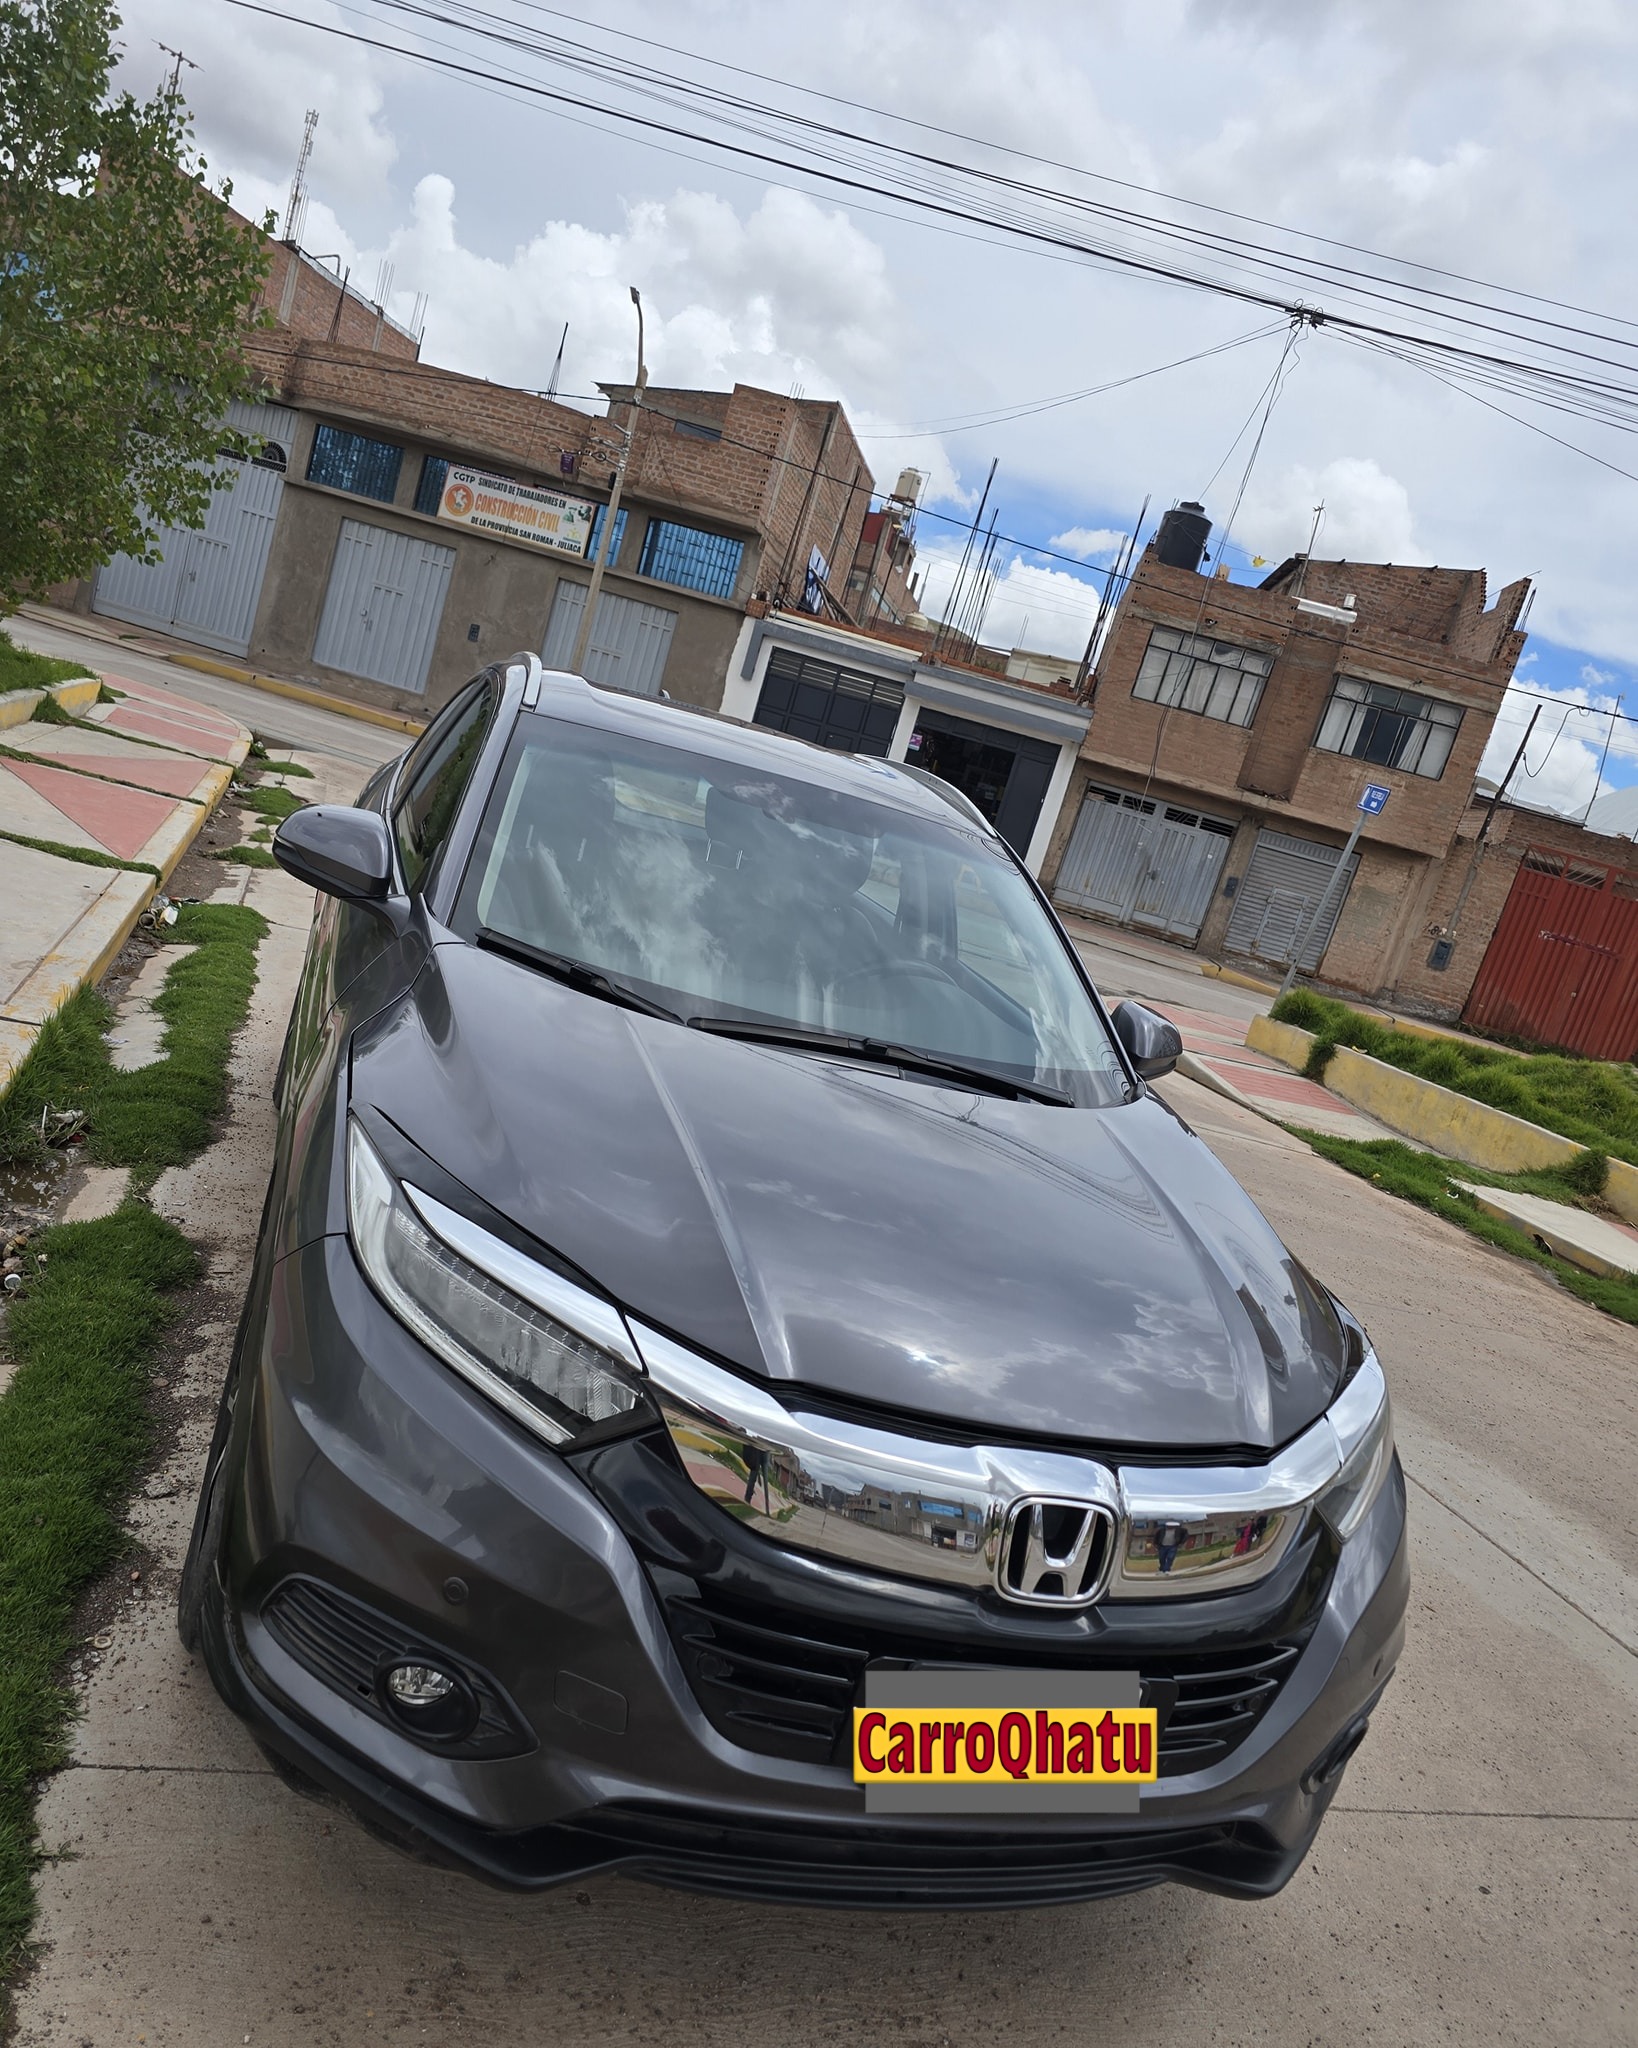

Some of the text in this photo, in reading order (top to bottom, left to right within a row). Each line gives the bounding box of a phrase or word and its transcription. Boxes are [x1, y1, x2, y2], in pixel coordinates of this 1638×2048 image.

[453, 471, 476, 484] CGTP
[477, 477, 567, 509] SINDICATO DE TRABAJADORES EN
[474, 492, 560, 533] CONSTRUCCIÓN CIVIL
[470, 516, 479, 525] DE
[479, 518, 487, 527] LA
[486, 520, 519, 536] PROVINCIA
[519, 529, 533, 540] SAN
[532, 533, 554, 546] ROMAN
[556, 540, 581, 554] JULIACA
